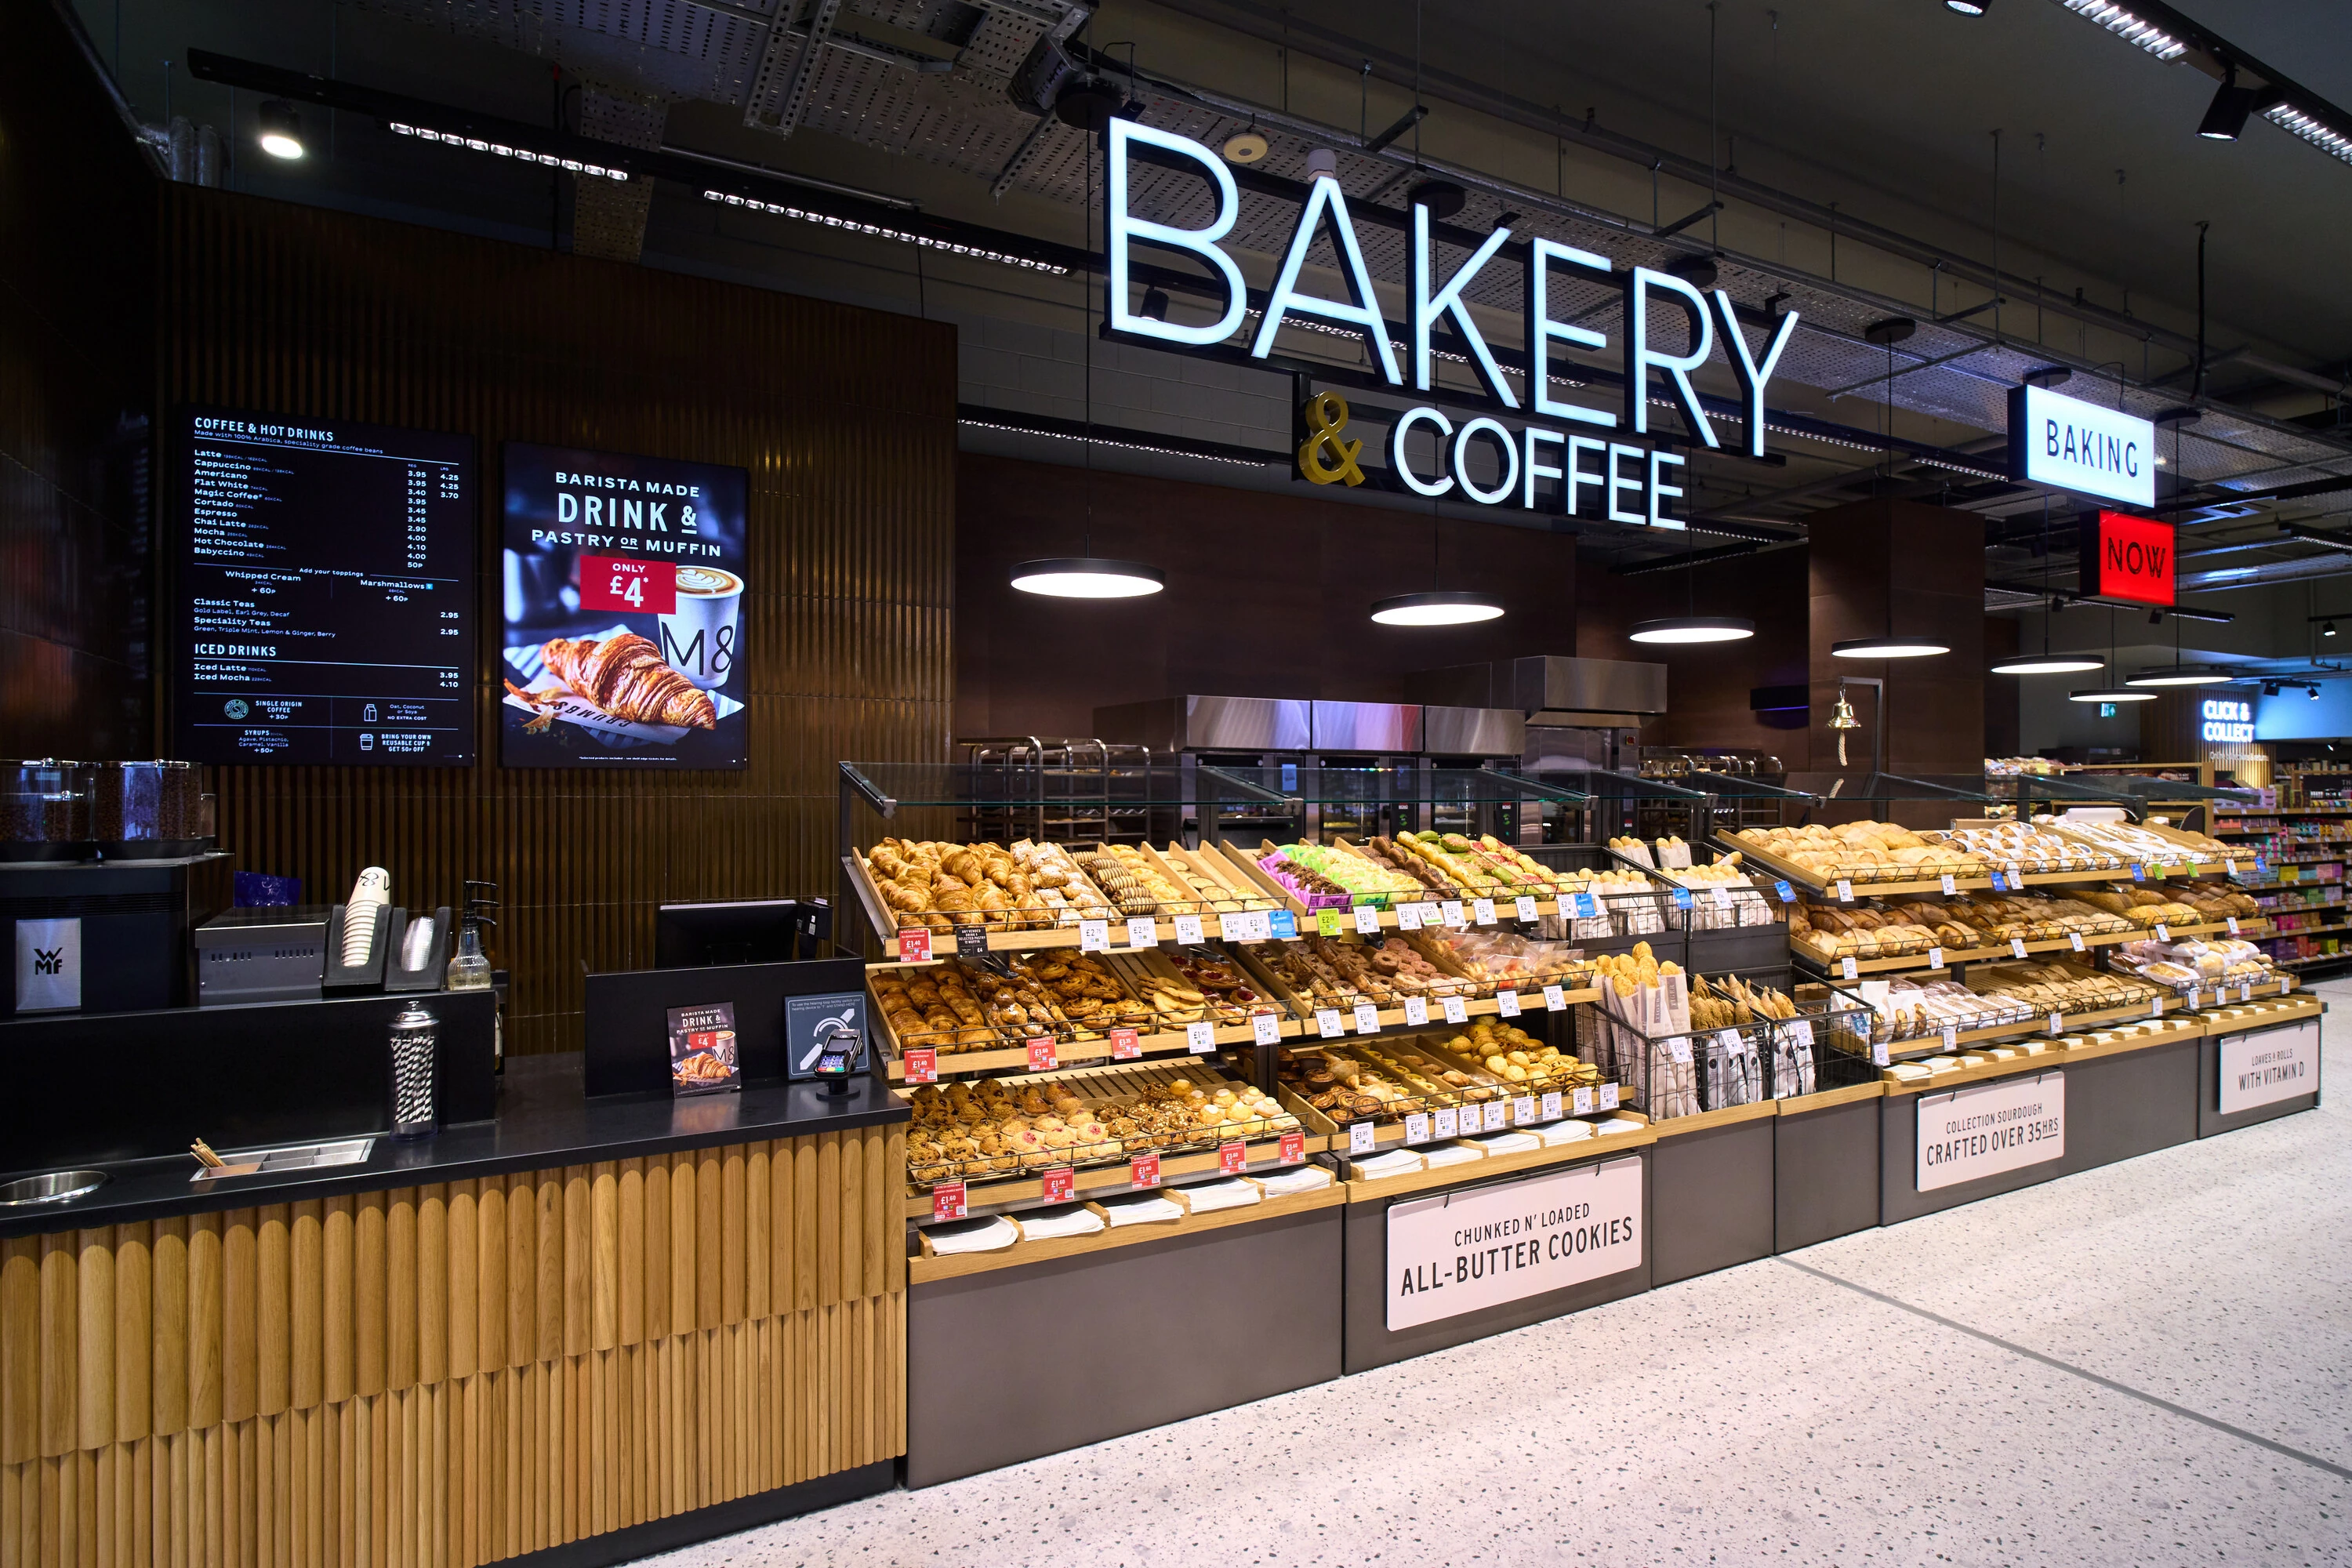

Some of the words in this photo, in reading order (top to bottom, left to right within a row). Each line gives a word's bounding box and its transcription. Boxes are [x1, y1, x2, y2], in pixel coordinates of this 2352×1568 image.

[1110, 116, 1798, 458] BAKERY
[194, 417, 245, 432] COFFEE
[248, 423, 256, 434] &
[260, 424, 285, 437] HOT
[288, 427, 333, 442] DRINKS
[284, 439, 320, 448] speciality
[2046, 418, 2137, 478] BAKING
[194, 449, 222, 458] Latte
[1299, 390, 1364, 488] &
[1393, 405, 1686, 531] COFFEE
[194, 459, 251, 470] Cappuccino
[194, 469, 248, 480] Americano
[194, 478, 216, 487] Flat
[218, 481, 249, 489] White
[556, 471, 640, 492] BARISTA
[646, 481, 701, 499] MADE
[194, 488, 224, 498] Magic
[194, 498, 234, 507] Cortado
[194, 507, 238, 517] Espresso
[558, 492, 668, 532] DRINK
[681, 505, 697, 535] &
[220, 519, 246, 528] Latte
[194, 527, 225, 535] Mocha
[214, 539, 264, 548] Chocolate
[532, 529, 614, 549] PASTRY
[620, 536, 638, 550] OR
[646, 539, 720, 557] MUFFIN
[194, 546, 245, 557] Babyccino
[2108, 537, 2165, 579] NOW
[612, 563, 646, 573] ONLY
[225, 571, 268, 580] Whipped
[270, 573, 301, 582] Cream
[360, 579, 425, 590] Marshmallows
[194, 598, 230, 607] Classic
[194, 616, 247, 626] Speciality
[194, 643, 225, 655] ICED
[229, 644, 276, 657] DRINKS
[553, 700, 634, 728] CRUMBS
[2203, 699, 2239, 720] CLICK
[2240, 702, 2250, 722] &
[2203, 721, 2255, 742] COLLECT
[33, 946, 64, 976] WMF
[682, 1015, 713, 1028] DRINK
[716, 1014, 720, 1024] &
[2252, 1053, 2271, 1066] LOAVES
[2277, 1048, 2293, 1061] ROLLS
[2238, 1071, 2261, 1091] WITH
[2264, 1062, 2296, 1085] VITAMIN
[2299, 1062, 2304, 1076] D
[1946, 1112, 1995, 1134] COLLECTION
[1998, 1103, 2042, 1123] SOURDOUGH
[1927, 1134, 1987, 1166] CRAFTED
[1991, 1126, 2024, 1151] OVER
[941, 1195, 956, 1205] £1.60
[1454, 1218, 1519, 1247] CHUNKED
[1525, 1214, 1537, 1231] N'
[1541, 1203, 1589, 1228] LOADED
[1401, 1239, 1540, 1297] ALL-BUTTER
[1548, 1216, 1632, 1261] COOKIES
